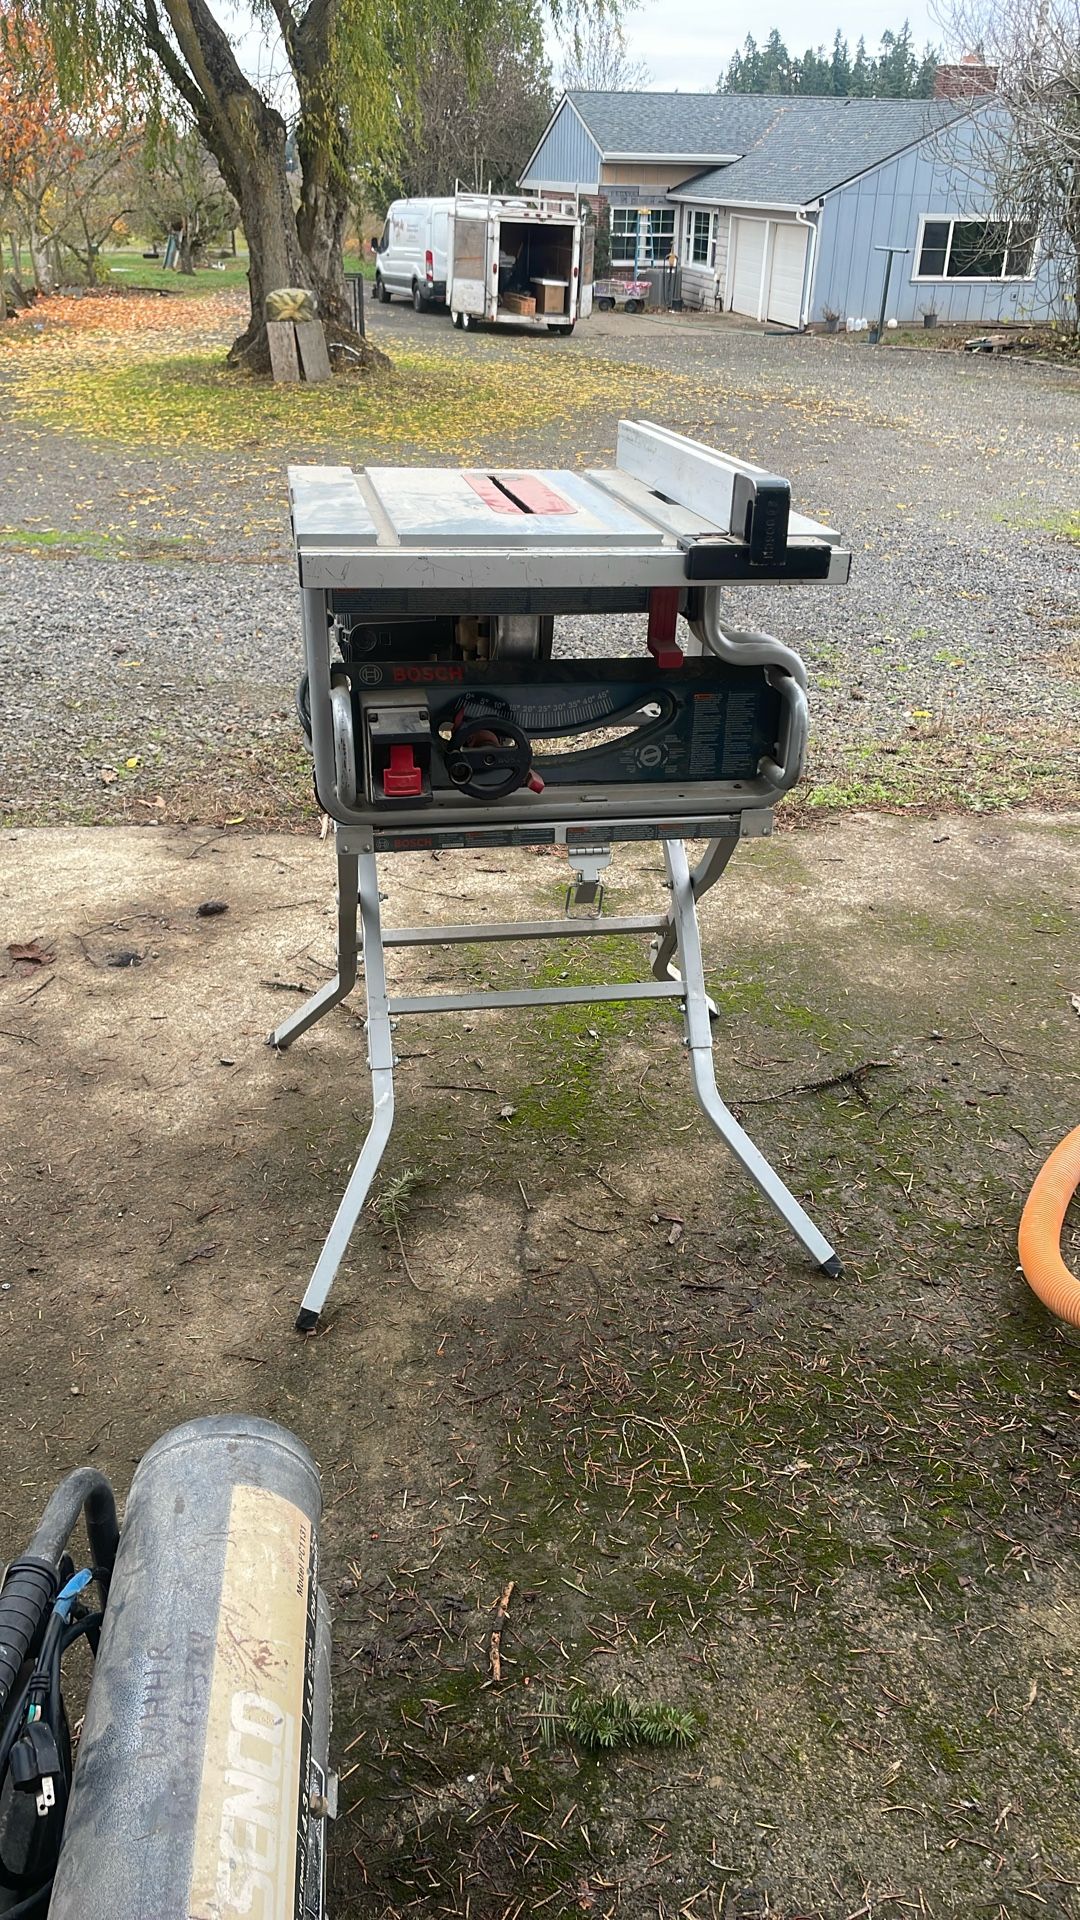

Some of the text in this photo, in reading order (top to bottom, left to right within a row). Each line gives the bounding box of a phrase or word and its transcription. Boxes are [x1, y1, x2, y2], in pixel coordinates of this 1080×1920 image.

[392, 667, 464, 682] BOSCH
[394, 838, 433, 848] BOSCH
[296, 1563, 305, 1597] Model
[216, 1690, 284, 1920] SENCO
